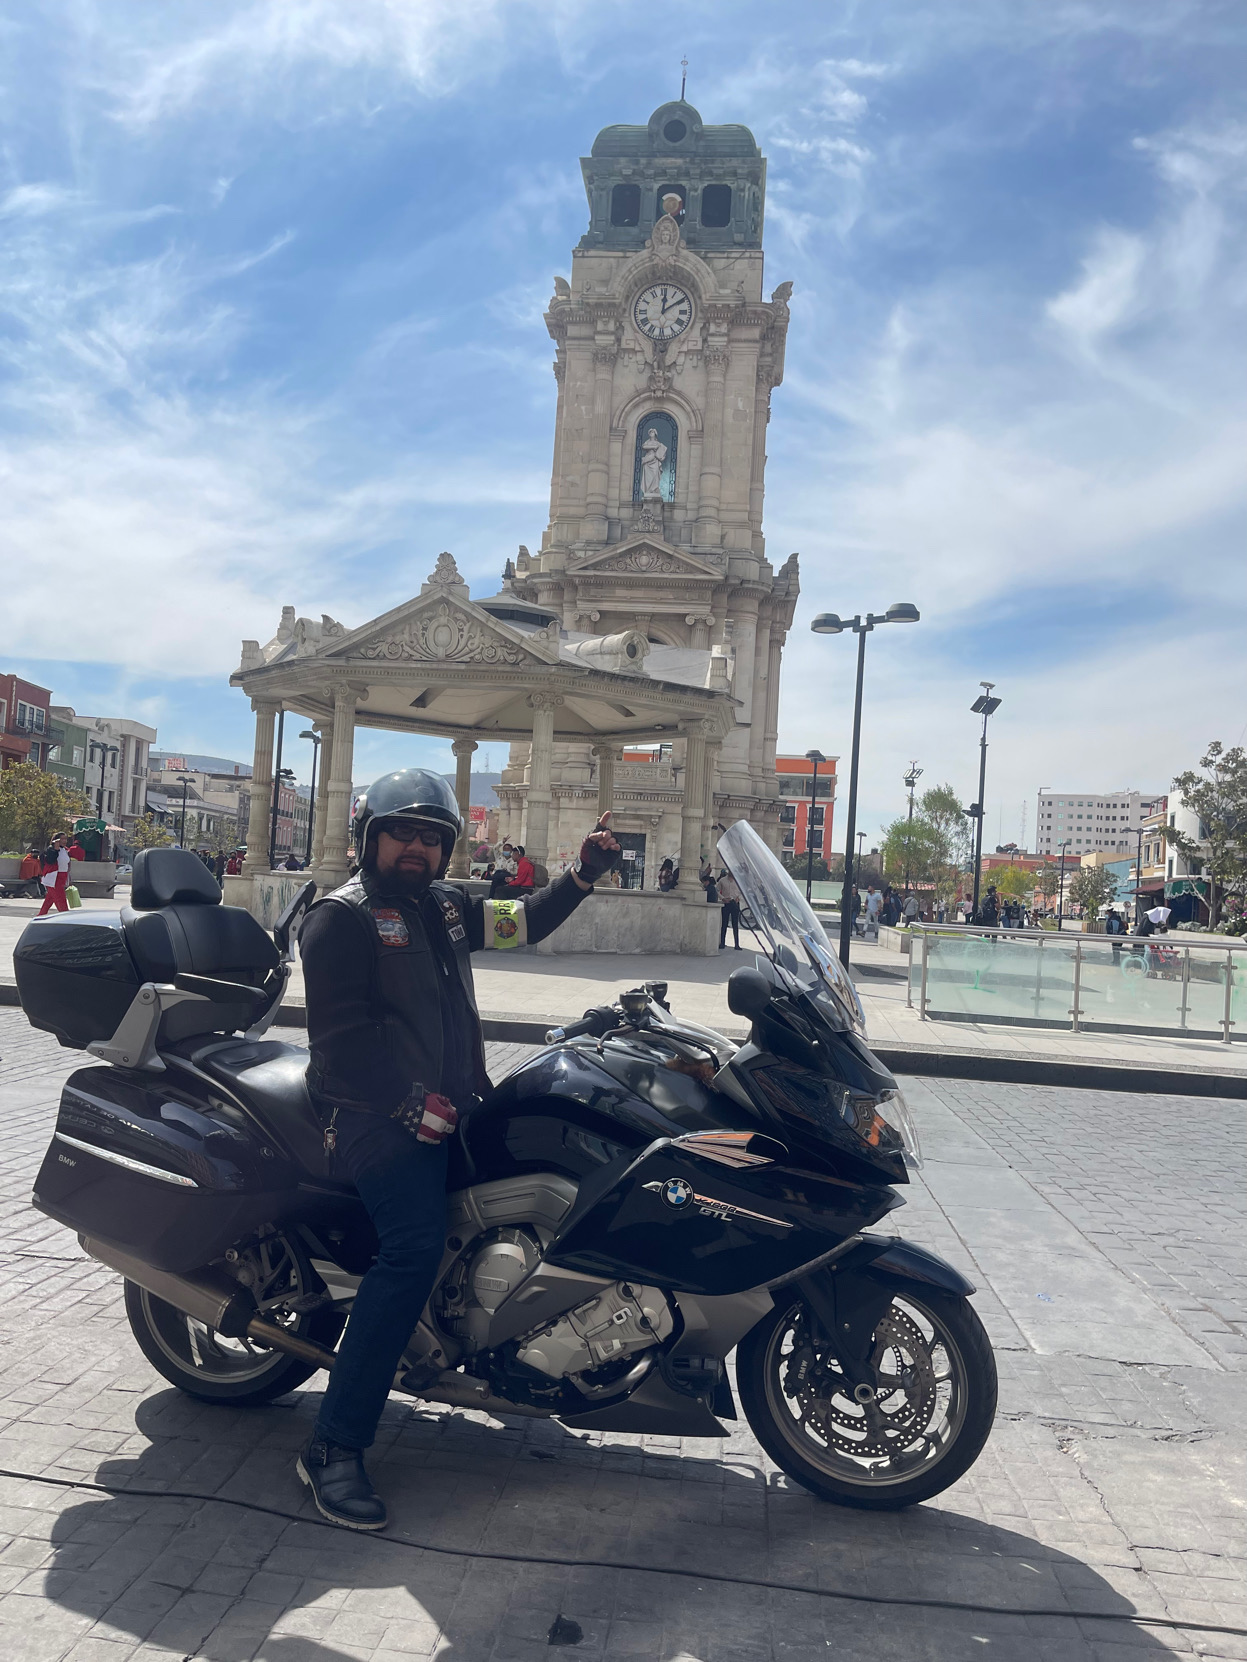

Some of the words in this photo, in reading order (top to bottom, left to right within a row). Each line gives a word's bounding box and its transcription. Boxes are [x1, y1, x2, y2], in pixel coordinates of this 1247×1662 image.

[58, 1154, 77, 1167] BMW
[667, 1181, 691, 1194] BMW
[698, 1207, 733, 1221] GTL
[476, 1278, 502, 1289] BMW
[797, 1359, 808, 1380] BMW
